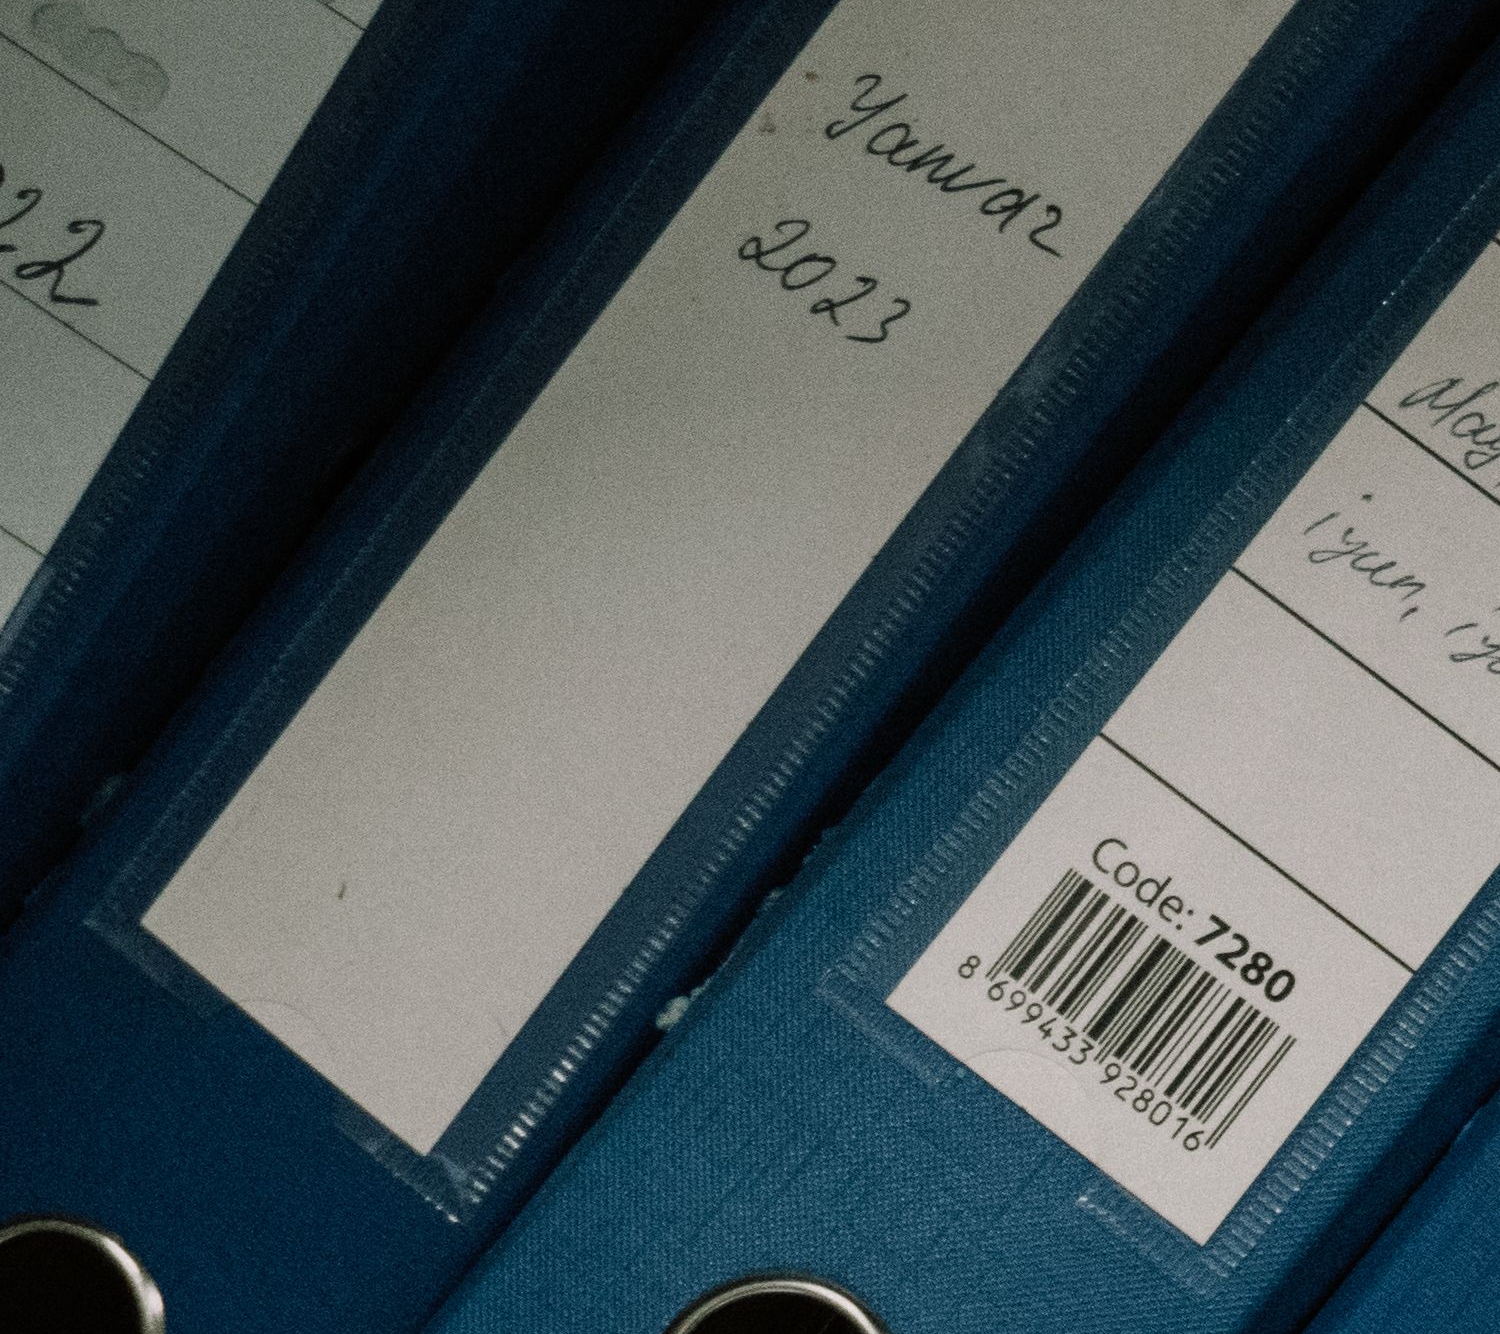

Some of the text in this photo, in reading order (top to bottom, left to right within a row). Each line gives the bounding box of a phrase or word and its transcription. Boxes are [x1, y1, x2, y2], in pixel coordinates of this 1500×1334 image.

[738, 220, 910, 343] 2023
[1092, 838, 1296, 1002] Code: 7280
[957, 954, 1204, 1153] 8 699433 928016
